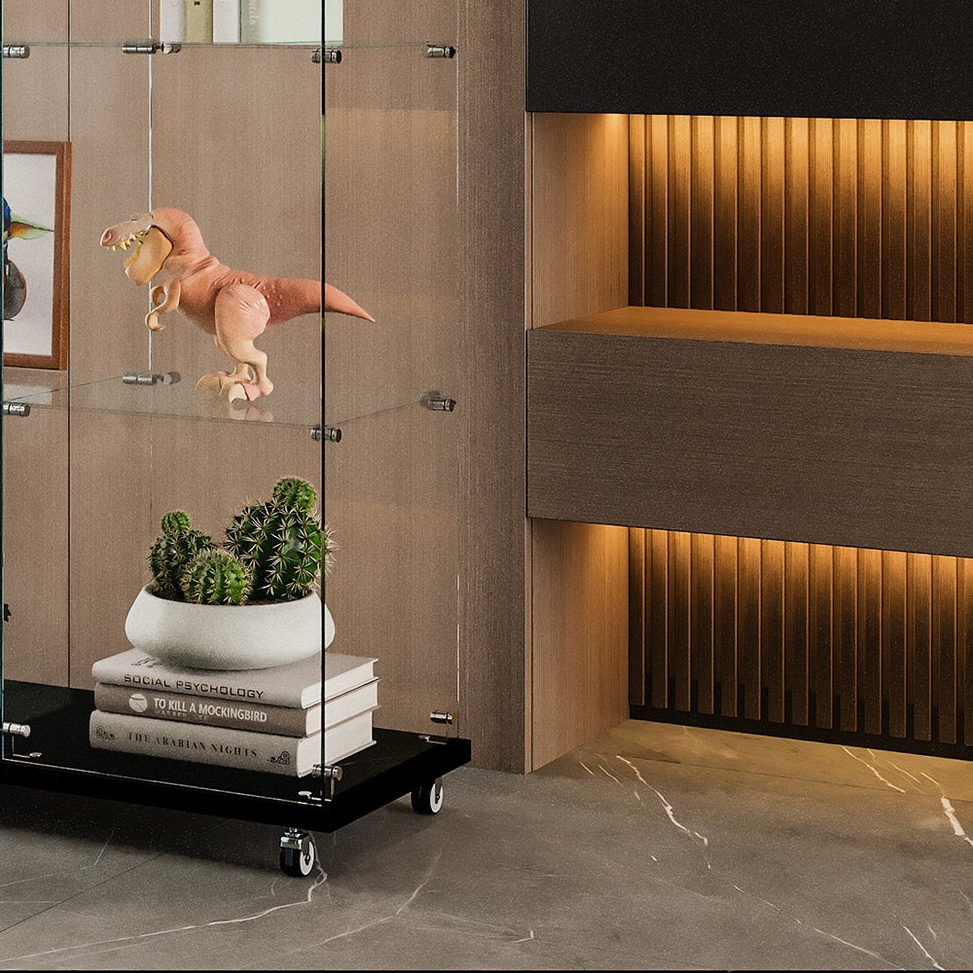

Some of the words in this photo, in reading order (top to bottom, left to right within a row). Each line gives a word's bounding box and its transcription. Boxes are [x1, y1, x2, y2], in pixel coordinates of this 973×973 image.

[123, 673, 172, 688] SOCIAL
[176, 680, 265, 700] PSYCHOLOGY
[153, 698, 166, 709] TO
[168, 699, 187, 712] KILL
[189, 703, 197, 713] A
[198, 703, 268, 722] MOCKINGBIRD
[128, 733, 149, 743] THE
[155, 735, 206, 751] ARABIAN
[211, 743, 258, 758] NIGHTS
